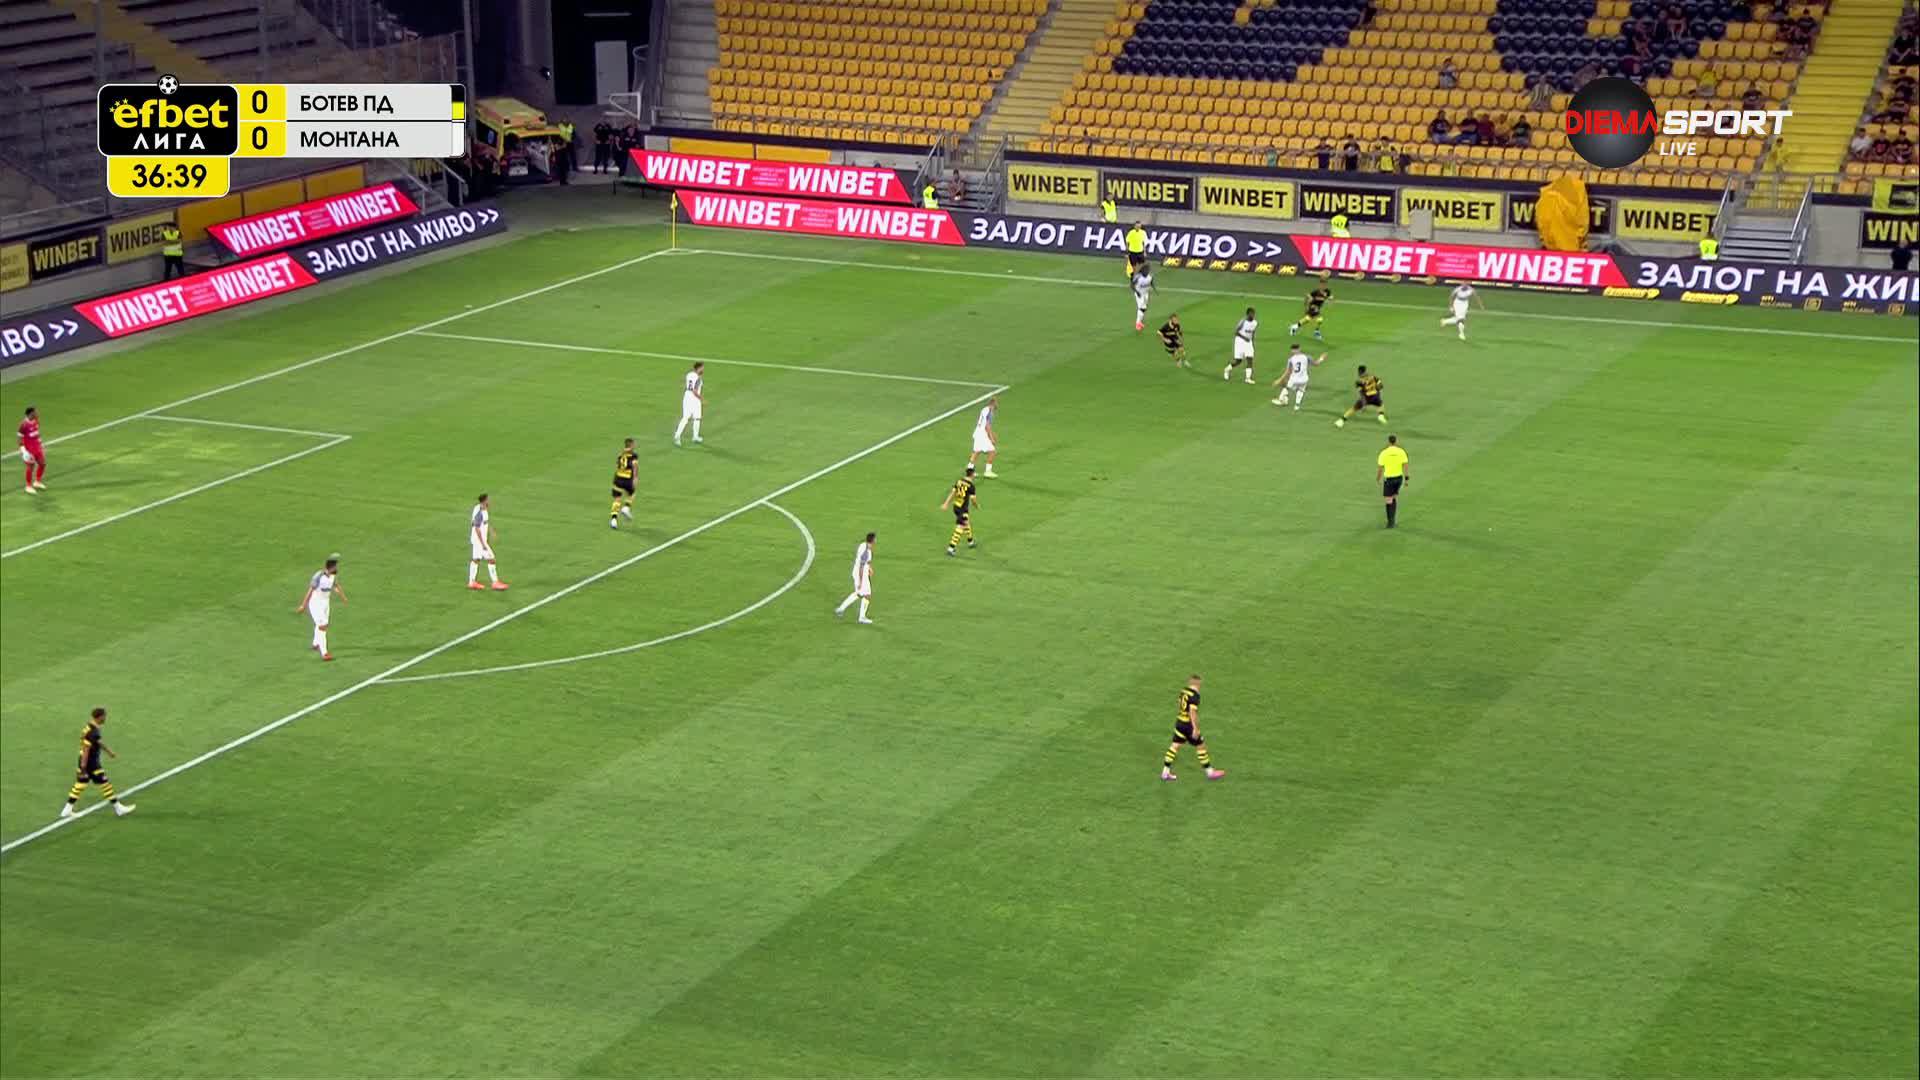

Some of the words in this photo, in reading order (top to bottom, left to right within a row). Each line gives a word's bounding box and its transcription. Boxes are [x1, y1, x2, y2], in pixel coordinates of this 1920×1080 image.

[645, 154, 751, 187] WINBET
[787, 165, 895, 198] WINBET
[1011, 173, 1093, 196] WINBET
[1106, 179, 1190, 204] WINBET
[1203, 186, 1289, 209] WINBET
[1303, 191, 1391, 217] WINBET
[224, 211, 305, 254] WINBET
[326, 186, 402, 228] WINBET
[693, 194, 801, 228] WINBET
[836, 206, 947, 240] WINBET
[32, 236, 100, 272] WINBET
[110, 224, 163, 253] WINBE
[307, 239, 376, 275] ЗАЛОГ
[384, 225, 415, 255] НА
[417, 208, 476, 243] ЖИВО
[969, 217, 1075, 247] ЗАЛОГ
[1083, 225, 1128, 251] НА
[1143, 231, 1238, 259] ЖИВО
[1311, 240, 1435, 275] WINBET
[1477, 251, 1608, 286] WINBET
[1637, 262, 1766, 291] ЗАЛОГ
[1776, 270, 1829, 297] НА
[94, 285, 189, 333] WINBET
[210, 258, 296, 302] WINBET
[1294, 362, 1301, 373] 3
